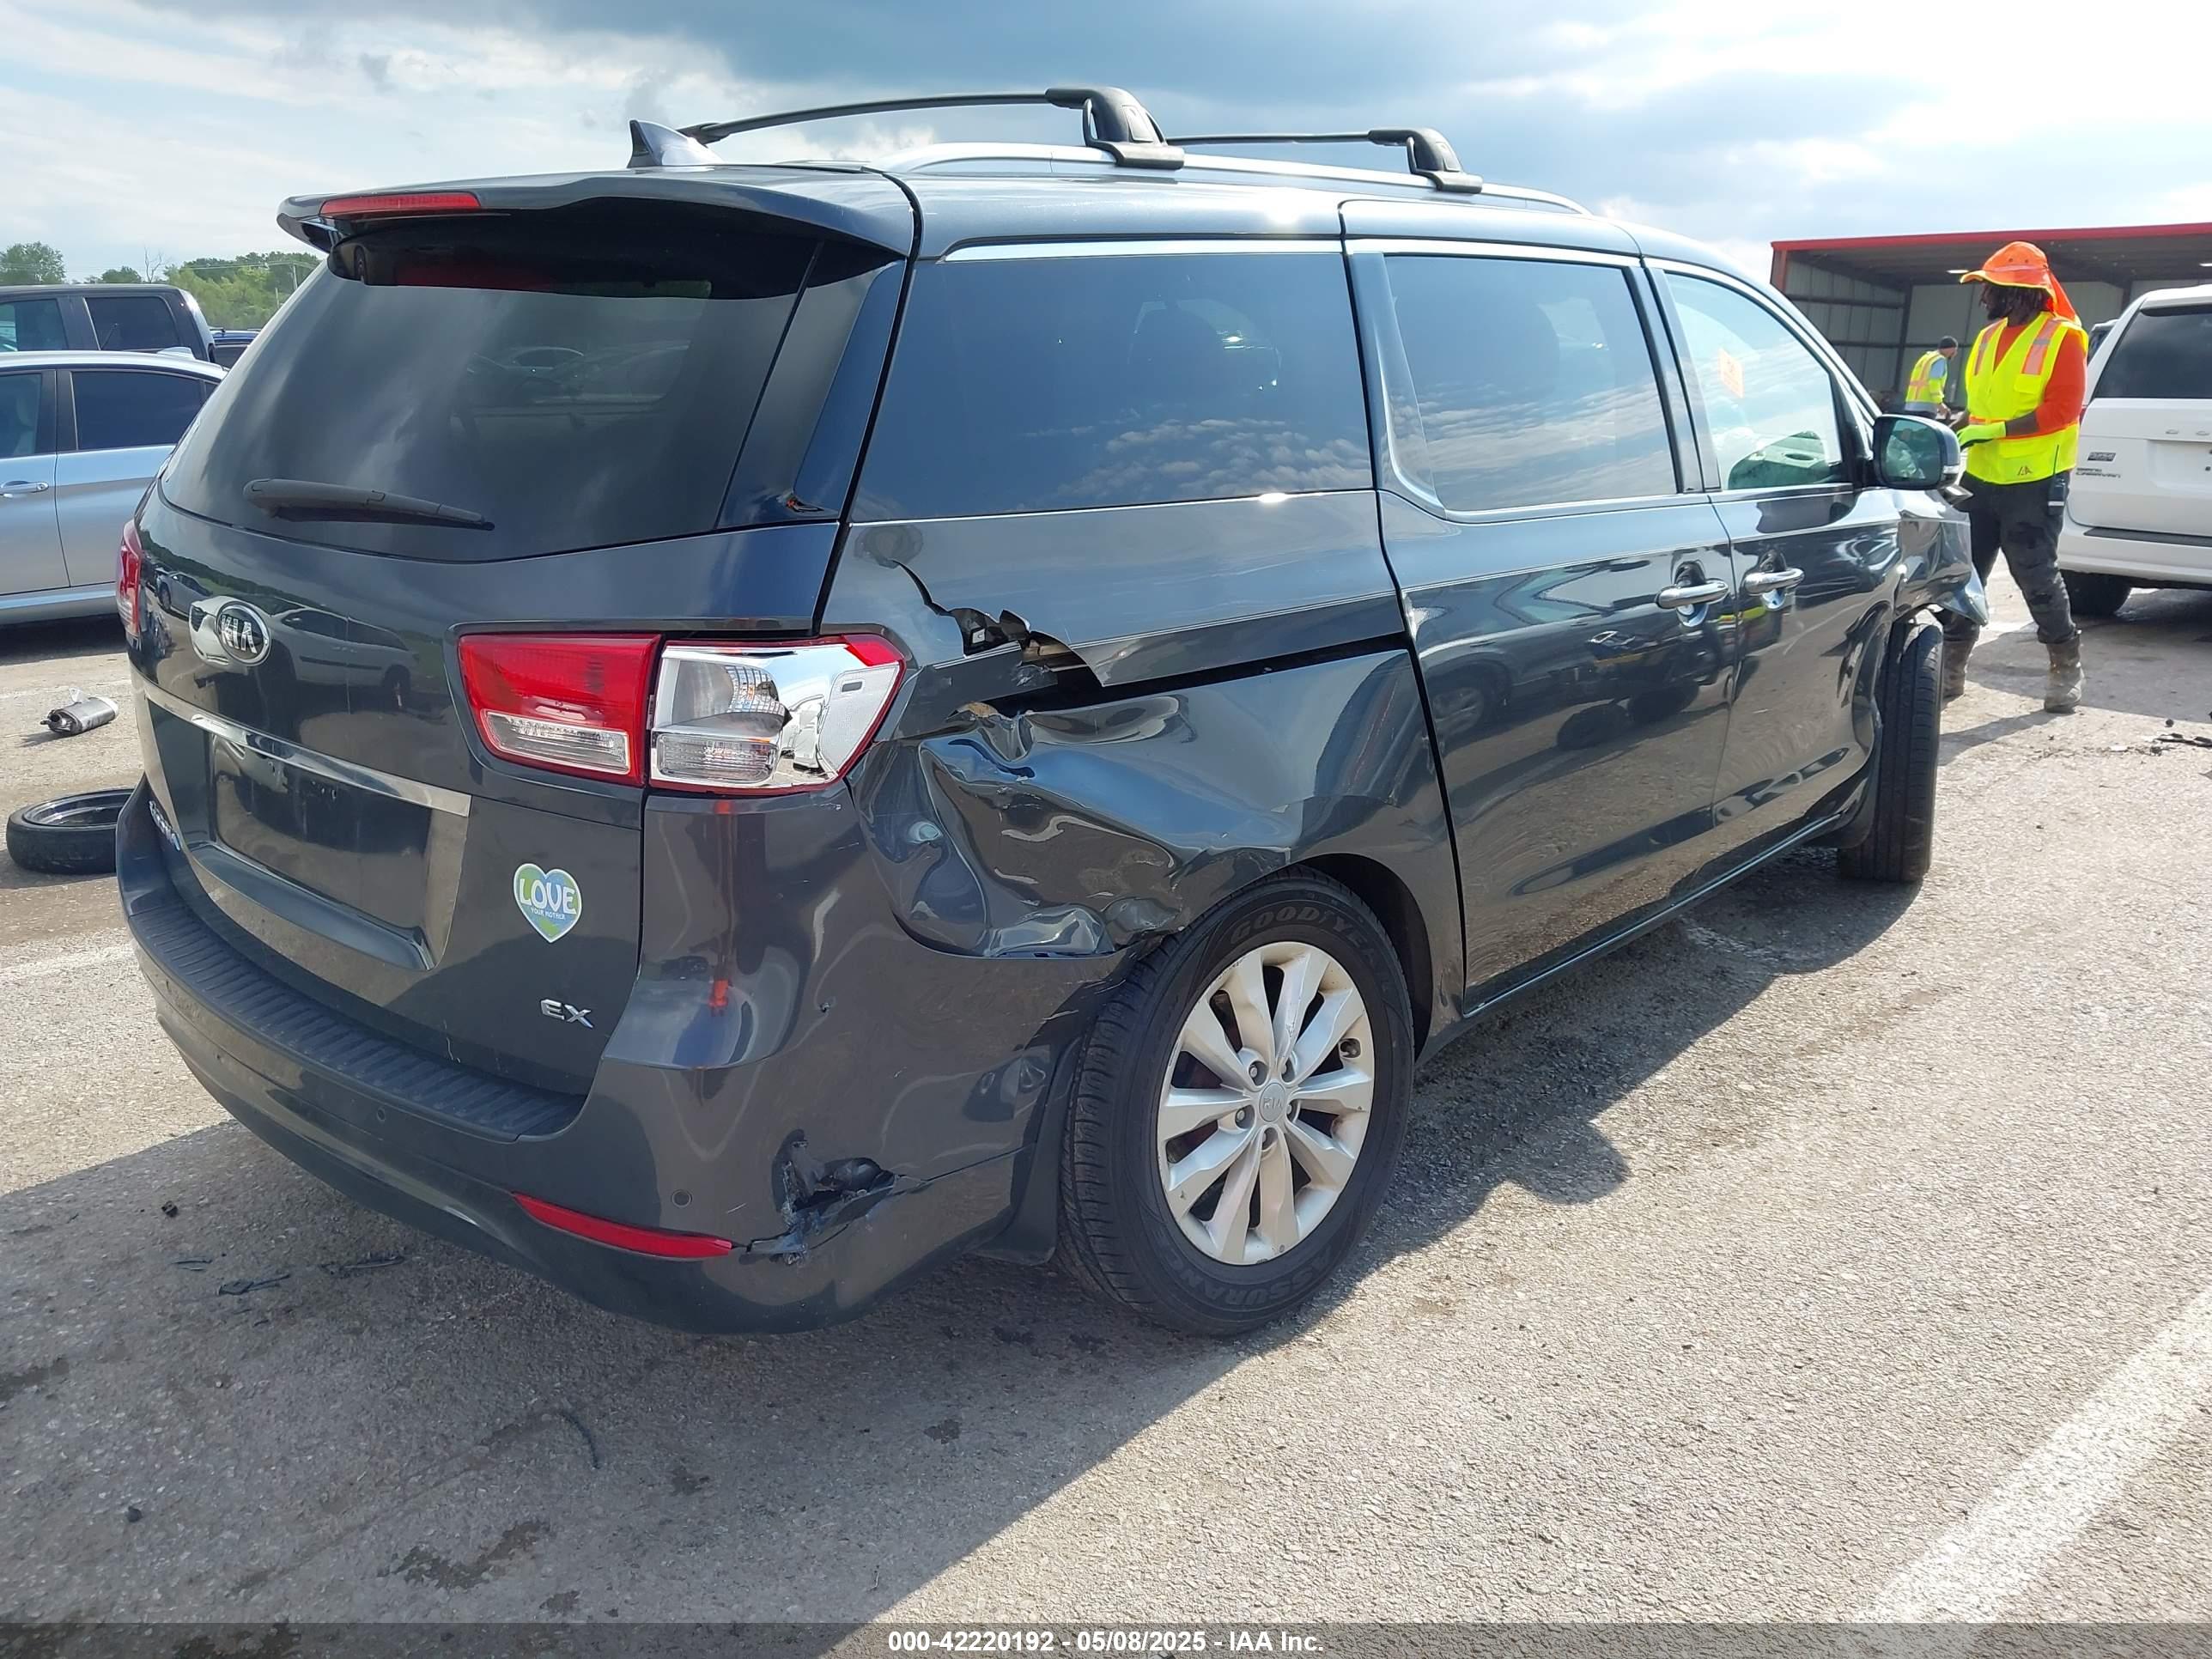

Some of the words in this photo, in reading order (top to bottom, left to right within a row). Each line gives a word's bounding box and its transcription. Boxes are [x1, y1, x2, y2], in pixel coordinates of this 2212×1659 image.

[221, 613, 258, 653] KIA
[519, 878, 577, 915] LOVE
[531, 908, 544, 917] YOUR
[544, 911, 566, 920] MOTHER
[540, 999, 593, 1029] EX
